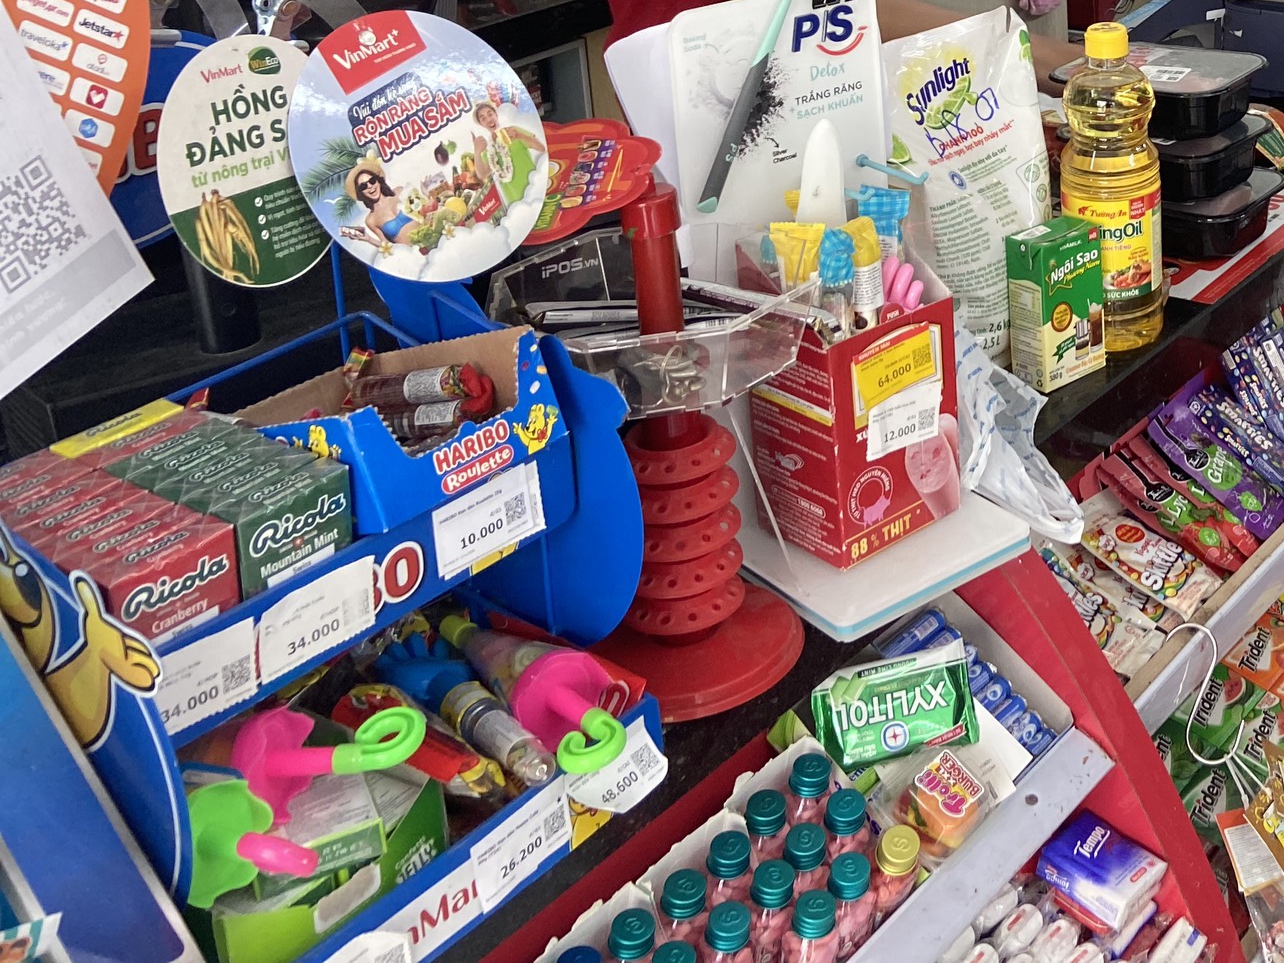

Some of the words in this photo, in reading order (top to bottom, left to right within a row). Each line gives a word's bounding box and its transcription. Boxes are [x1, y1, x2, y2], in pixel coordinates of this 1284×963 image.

[79, 18, 119, 40] Jetstar
[200, 62, 243, 84] VinMart
[810, 61, 845, 81] Detox
[211, 84, 288, 126] HỒNG
[795, 88, 831, 106] TRẮNG
[834, 81, 863, 95] RĂNG
[797, 105, 826, 120] SẠCH
[828, 94, 863, 111] KHUẨN
[906, 57, 971, 126] Sunlight
[354, 111, 390, 146] RỘN
[387, 86, 433, 124] RÀNG
[377, 116, 428, 160] MUA
[424, 88, 469, 130] SẮM
[185, 125, 255, 168] ĐẢNG
[772, 148, 789, 157] Silver
[772, 152, 798, 164] Charcoal
[192, 171, 208, 189] từ
[211, 162, 248, 184] nông
[251, 151, 275, 172] trại
[1050, 258, 1075, 285] Ngôi
[1076, 248, 1098, 265] Sao
[878, 362, 912, 388] 64.000
[433, 419, 510, 475] HARIBO
[884, 423, 916, 443] 12.000
[445, 446, 512, 492] Roulette
[1208, 444, 1229, 485] Grape
[250, 492, 347, 559] Ricola
[460, 518, 503, 550] 10.000
[851, 537, 868, 559] 88
[882, 513, 912, 541] THỊT
[260, 541, 313, 579] Mountain
[314, 527, 340, 552] Mint
[122, 554, 229, 622] Ricola
[151, 598, 209, 635] Cranberry
[287, 619, 340, 657] 34.000
[1239, 626, 1272, 674] Trident
[160, 685, 219, 724] 34.000
[838, 680, 949, 731] XYLITOL
[600, 770, 639, 805] 48.600
[500, 835, 543, 879] 26.200
[1073, 825, 1107, 859] Tempo
